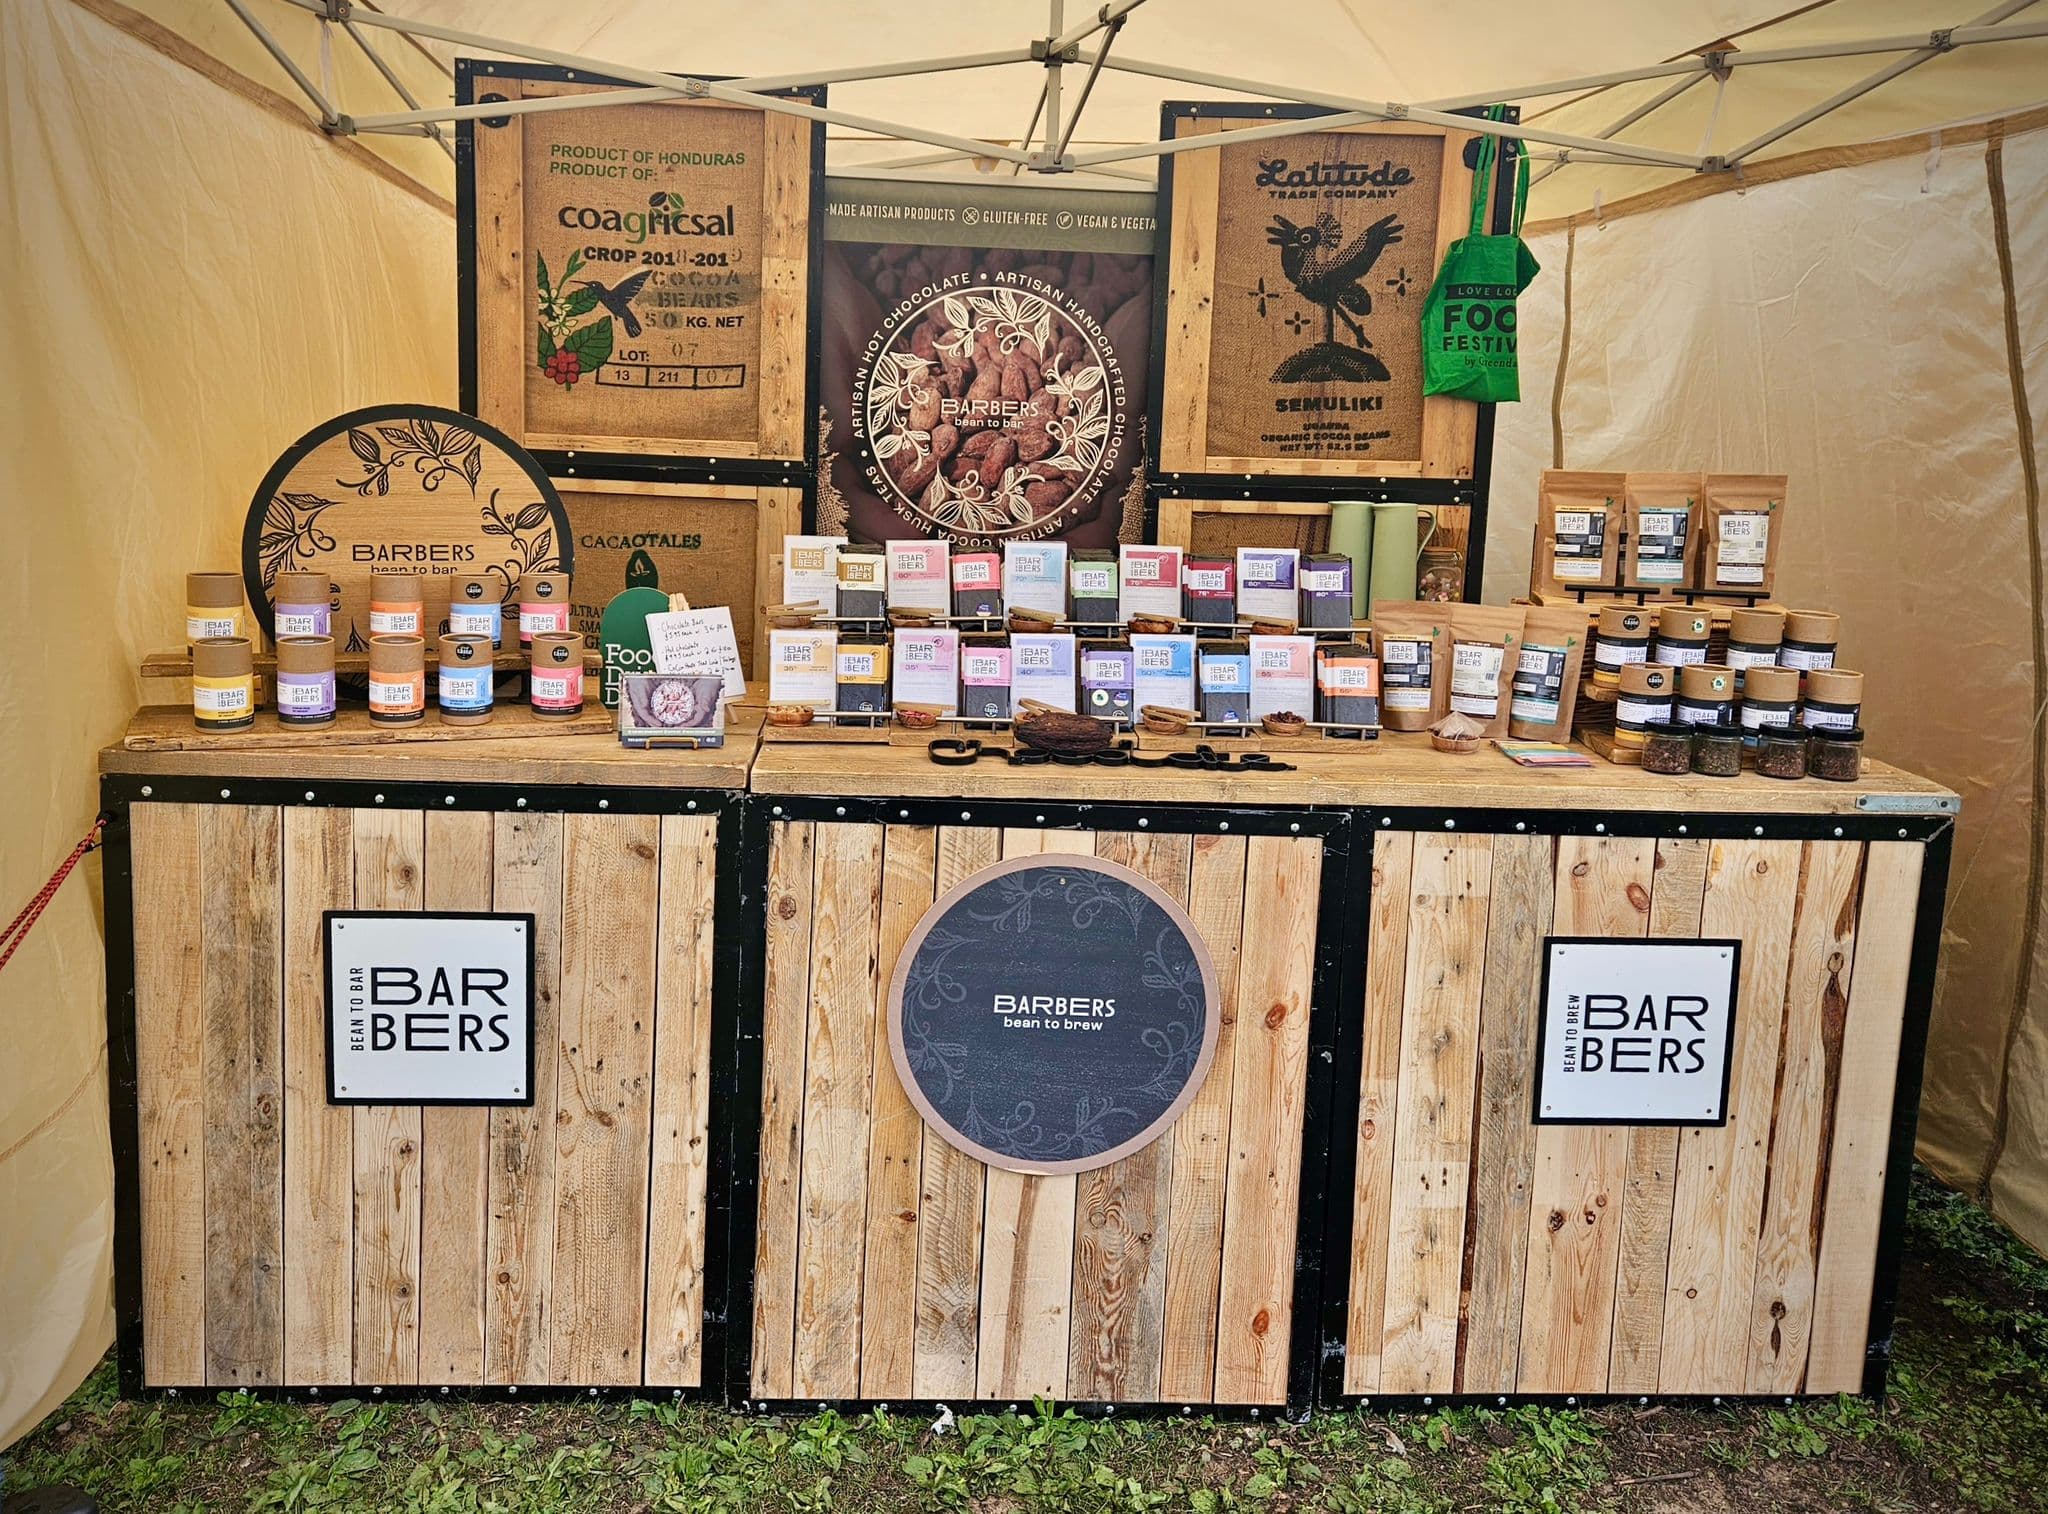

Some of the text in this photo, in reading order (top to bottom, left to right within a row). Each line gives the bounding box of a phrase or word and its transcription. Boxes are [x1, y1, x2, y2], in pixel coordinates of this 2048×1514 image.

[551, 144, 746, 166] PRODUCT OF HONDURAS
[550, 162, 658, 182] PRODUCT OF:
[1255, 158, 1415, 188] Latitude
[1269, 189, 1397, 199] TRADE COMPANY
[860, 206, 900, 219] ARTISAN
[904, 207, 955, 221] PRODUCTS
[983, 210, 1048, 225] GLUTEN-FREE
[1077, 214, 1108, 228] VEGAN
[1111, 216, 1118, 228] &
[558, 204, 735, 244] coagricsal
[584, 246, 636, 263] CROP
[651, 270, 741, 288] COCOA
[1458, 286, 1490, 295] LOVE
[686, 316, 712, 328] KG.
[715, 316, 744, 328] NET
[1443, 303, 1517, 333] FOO
[619, 350, 650, 362] LOT:
[852, 272, 971, 439] ARTISAN HOT CHOCOLATE
[1464, 356, 1476, 368] by
[615, 370, 630, 381] 13
[658, 371, 679, 383] 211
[994, 272, 1126, 504] ARTISAN HANDCRAFTED CHOCOLATE
[941, 399, 1038, 417] BARBERS
[1275, 397, 1382, 412] SEMULIKI
[954, 418, 1024, 429] bean to bar
[1261, 431, 1391, 441] ORGANIC COCOA BEANS
[865, 466, 892, 503] TEAS
[893, 503, 931, 533] HUSK
[581, 533, 701, 549] CACAOTALES
[352, 544, 475, 562] BARBERS
[413, 565, 427, 574] to
[433, 565, 457, 574] bar
[849, 564, 871, 572] BAR
[1252, 570, 1274, 578] BERS
[605, 644, 654, 665] Foo
[787, 645, 811, 653] BAR
[909, 644, 933, 652] BAR
[1024, 648, 1049, 656] BAR
[1265, 651, 1287, 659] BAR
[1146, 658, 1169, 666] BERS
[1461, 659, 1482, 667] BERS
[221, 690, 244, 699] BAR
[388, 693, 411, 701] BERS
[221, 699, 245, 707] BERS
[371, 967, 509, 1007] BAR
[350, 967, 364, 1051] BEAN TO BAR
[994, 995, 1115, 1017] BARBERS
[1584, 994, 1709, 1031] BAR
[1004, 1017, 1103, 1031] bean to brew
[371, 1013, 510, 1051] BERS
[1563, 994, 1580, 1072] BEAN TO BREW
[1581, 1037, 1705, 1073] BERS
